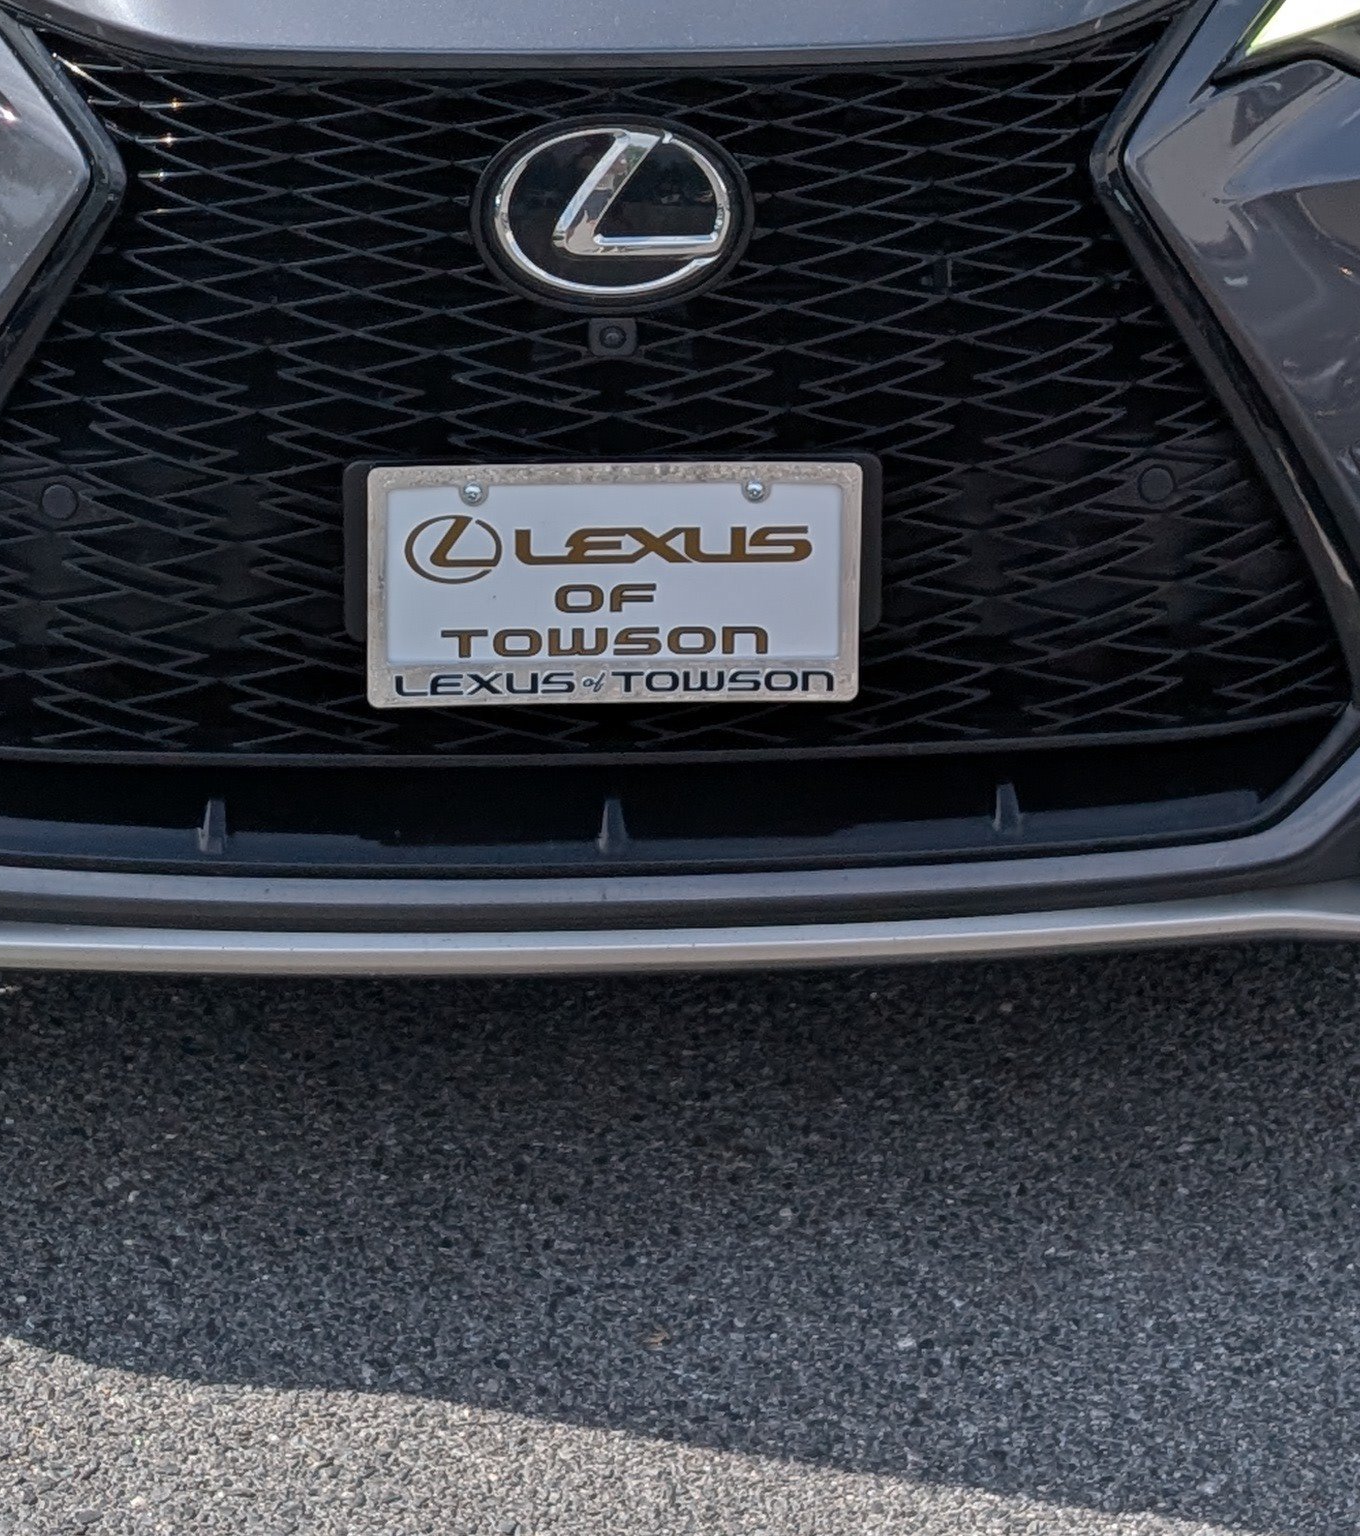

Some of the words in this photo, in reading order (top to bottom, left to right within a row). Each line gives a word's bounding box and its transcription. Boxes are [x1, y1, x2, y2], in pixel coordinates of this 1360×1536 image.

[514, 524, 813, 566] LEXUS
[554, 582, 657, 614] OF
[440, 625, 769, 659] TOWSON
[394, 671, 577, 697] LEXUS
[582, 671, 607, 693] of
[611, 669, 835, 694] TOWSON
